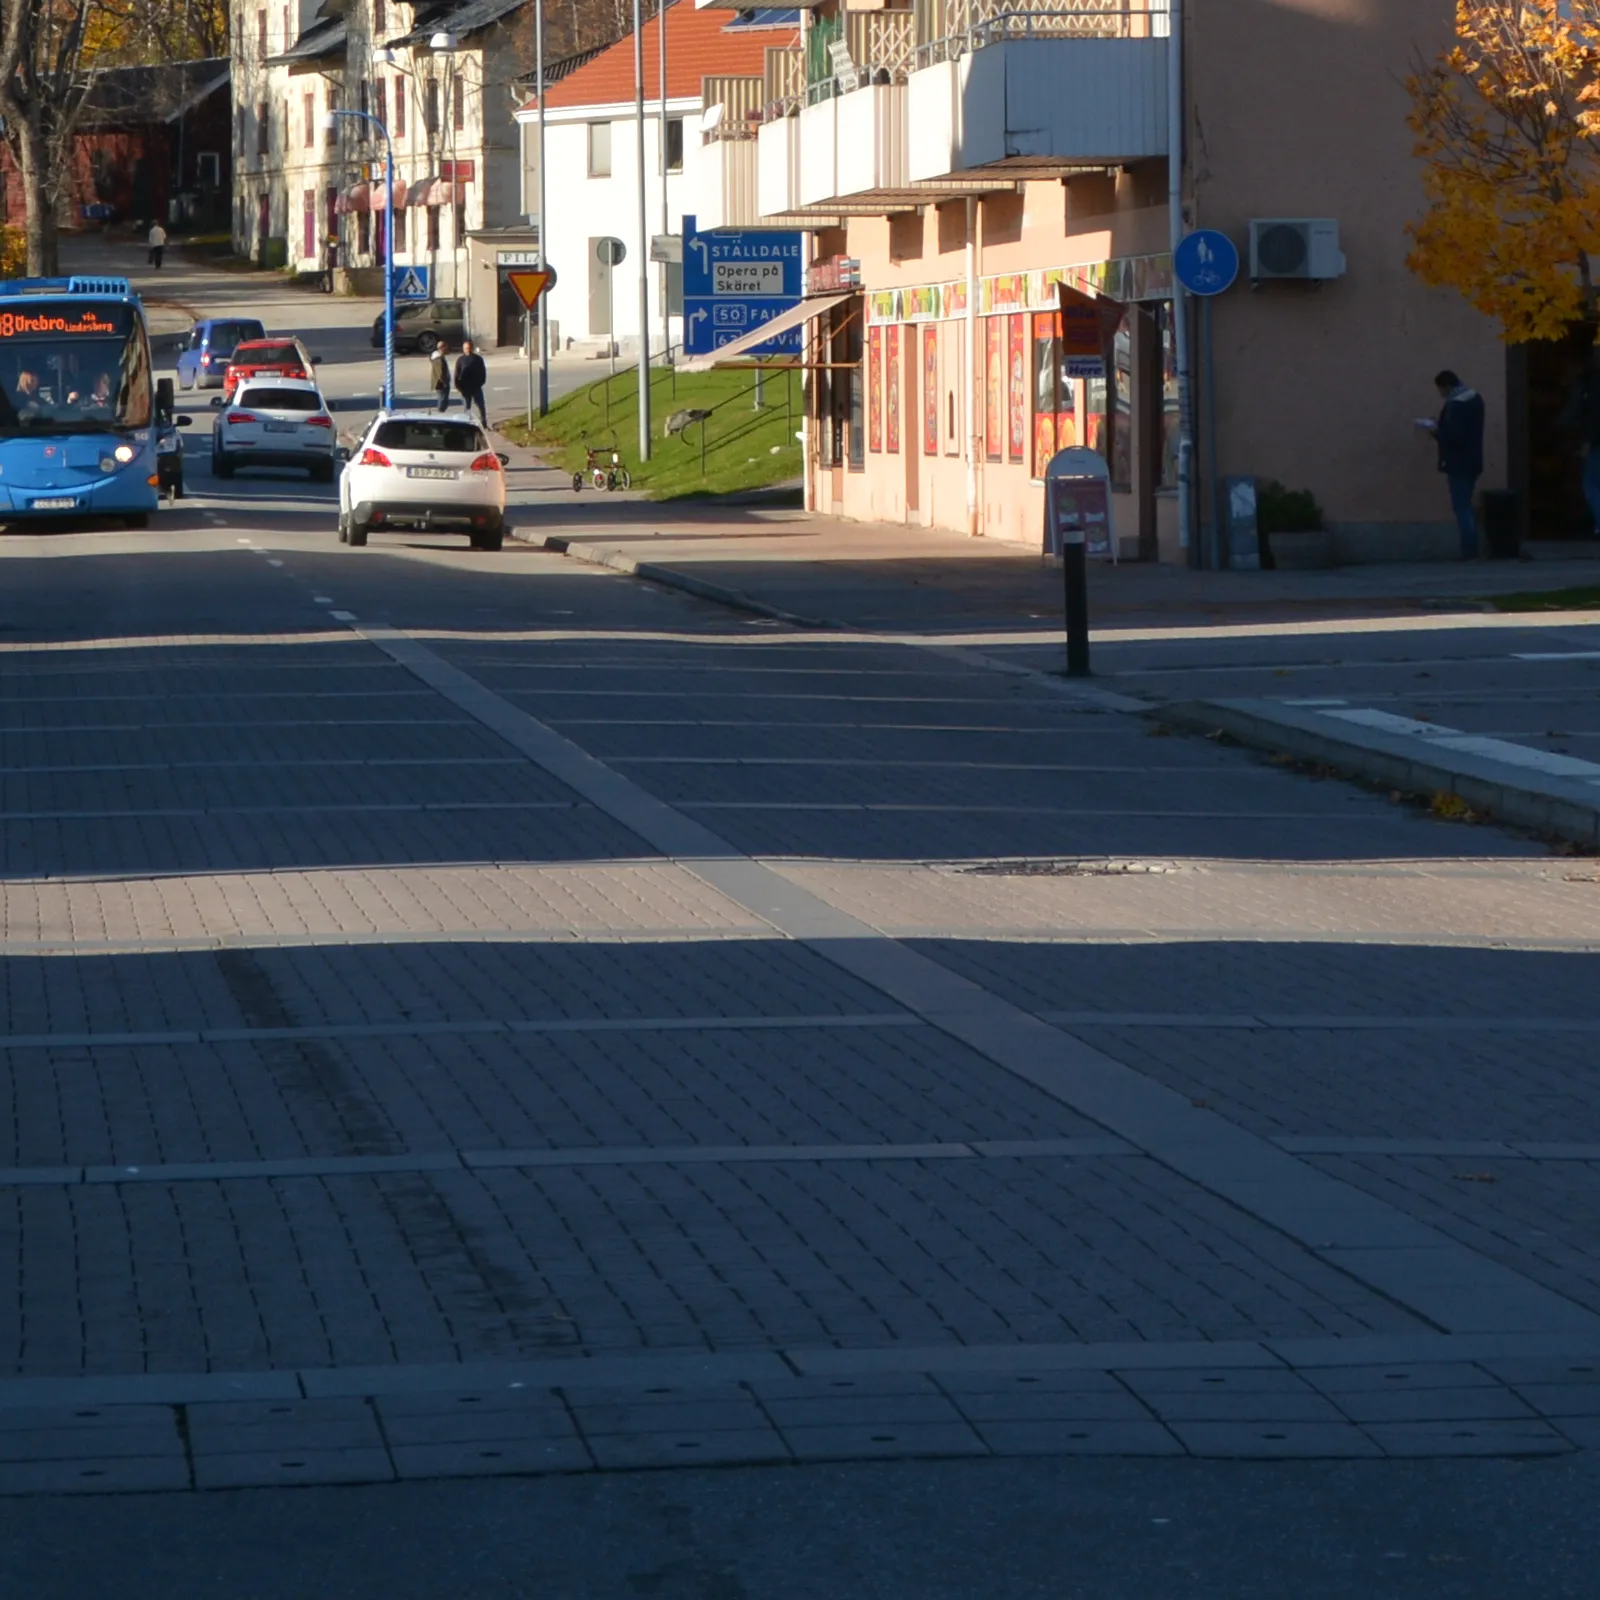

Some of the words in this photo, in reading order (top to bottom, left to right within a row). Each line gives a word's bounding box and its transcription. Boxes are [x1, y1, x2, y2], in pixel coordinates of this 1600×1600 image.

[716, 265, 758, 279] Opera
[762, 264, 779, 279] på
[716, 280, 762, 292] Skäret
[81, 311, 97, 322] via
[720, 309, 741, 321] 50
[750, 308, 787, 321] FAL
[15, 314, 65, 332] Örebro
[64, 321, 114, 333] Lindesberg
[1069, 364, 1103, 377] Here
